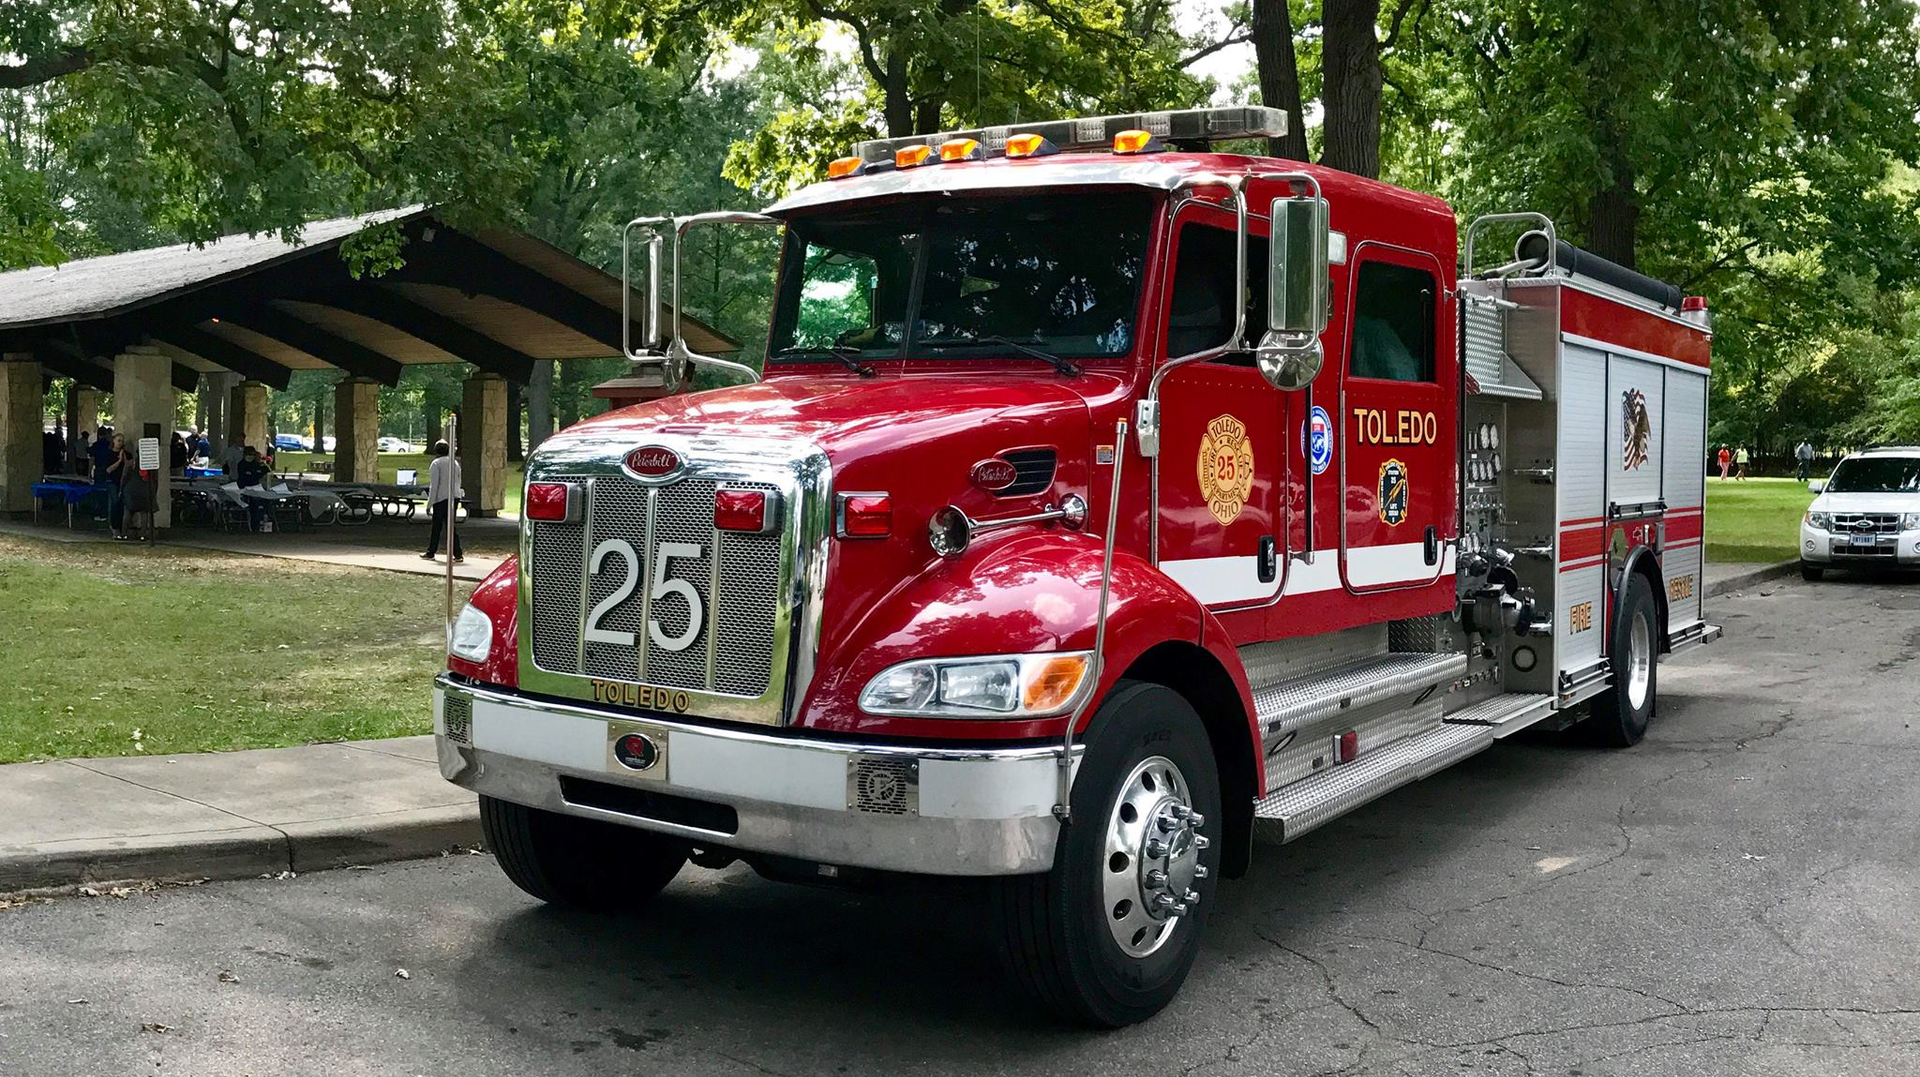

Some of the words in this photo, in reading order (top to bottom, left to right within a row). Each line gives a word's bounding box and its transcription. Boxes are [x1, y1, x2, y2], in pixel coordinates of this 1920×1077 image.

[1211, 419, 1241, 439] TOLEDO
[1354, 408, 1437, 445] TOLEDO
[631, 451, 675, 469] Peterbilt
[1217, 455, 1235, 480] 25
[1212, 500, 1239, 518] OHIO
[584, 538, 703, 651] 25
[1569, 601, 1592, 635] FIRE
[591, 679, 690, 712] TOLEDO
